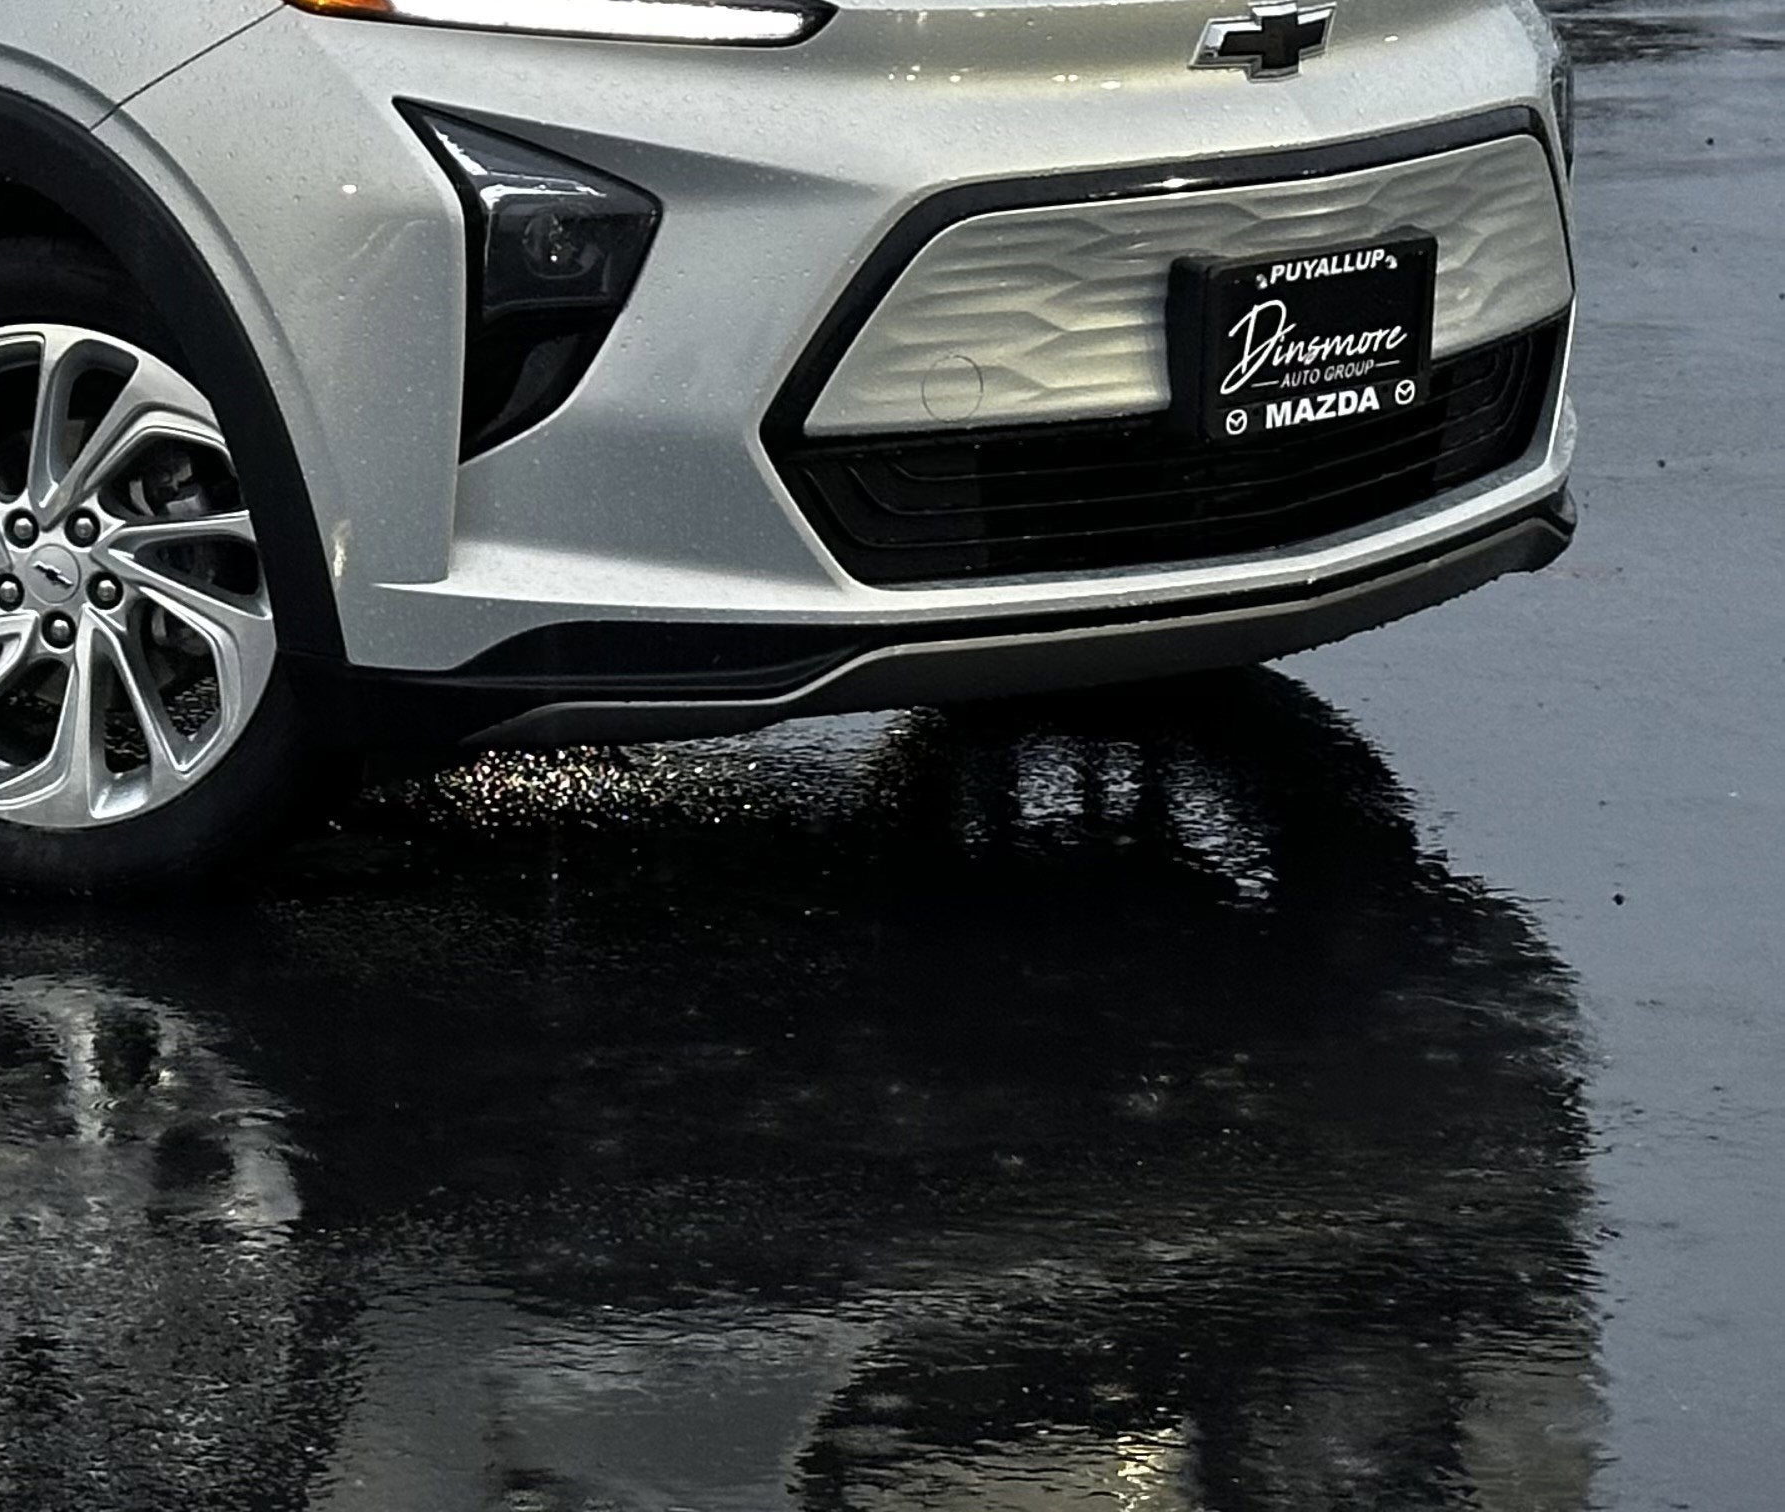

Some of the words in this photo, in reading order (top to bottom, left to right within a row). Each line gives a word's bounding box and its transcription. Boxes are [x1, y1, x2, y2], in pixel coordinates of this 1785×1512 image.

[1269, 249, 1385, 285] PUYALLUP
[1220, 299, 1408, 395] Dinsmore
[1280, 368, 1321, 388] AUTO
[1323, 359, 1375, 382] GROUP
[1265, 386, 1380, 429] MAZDA
